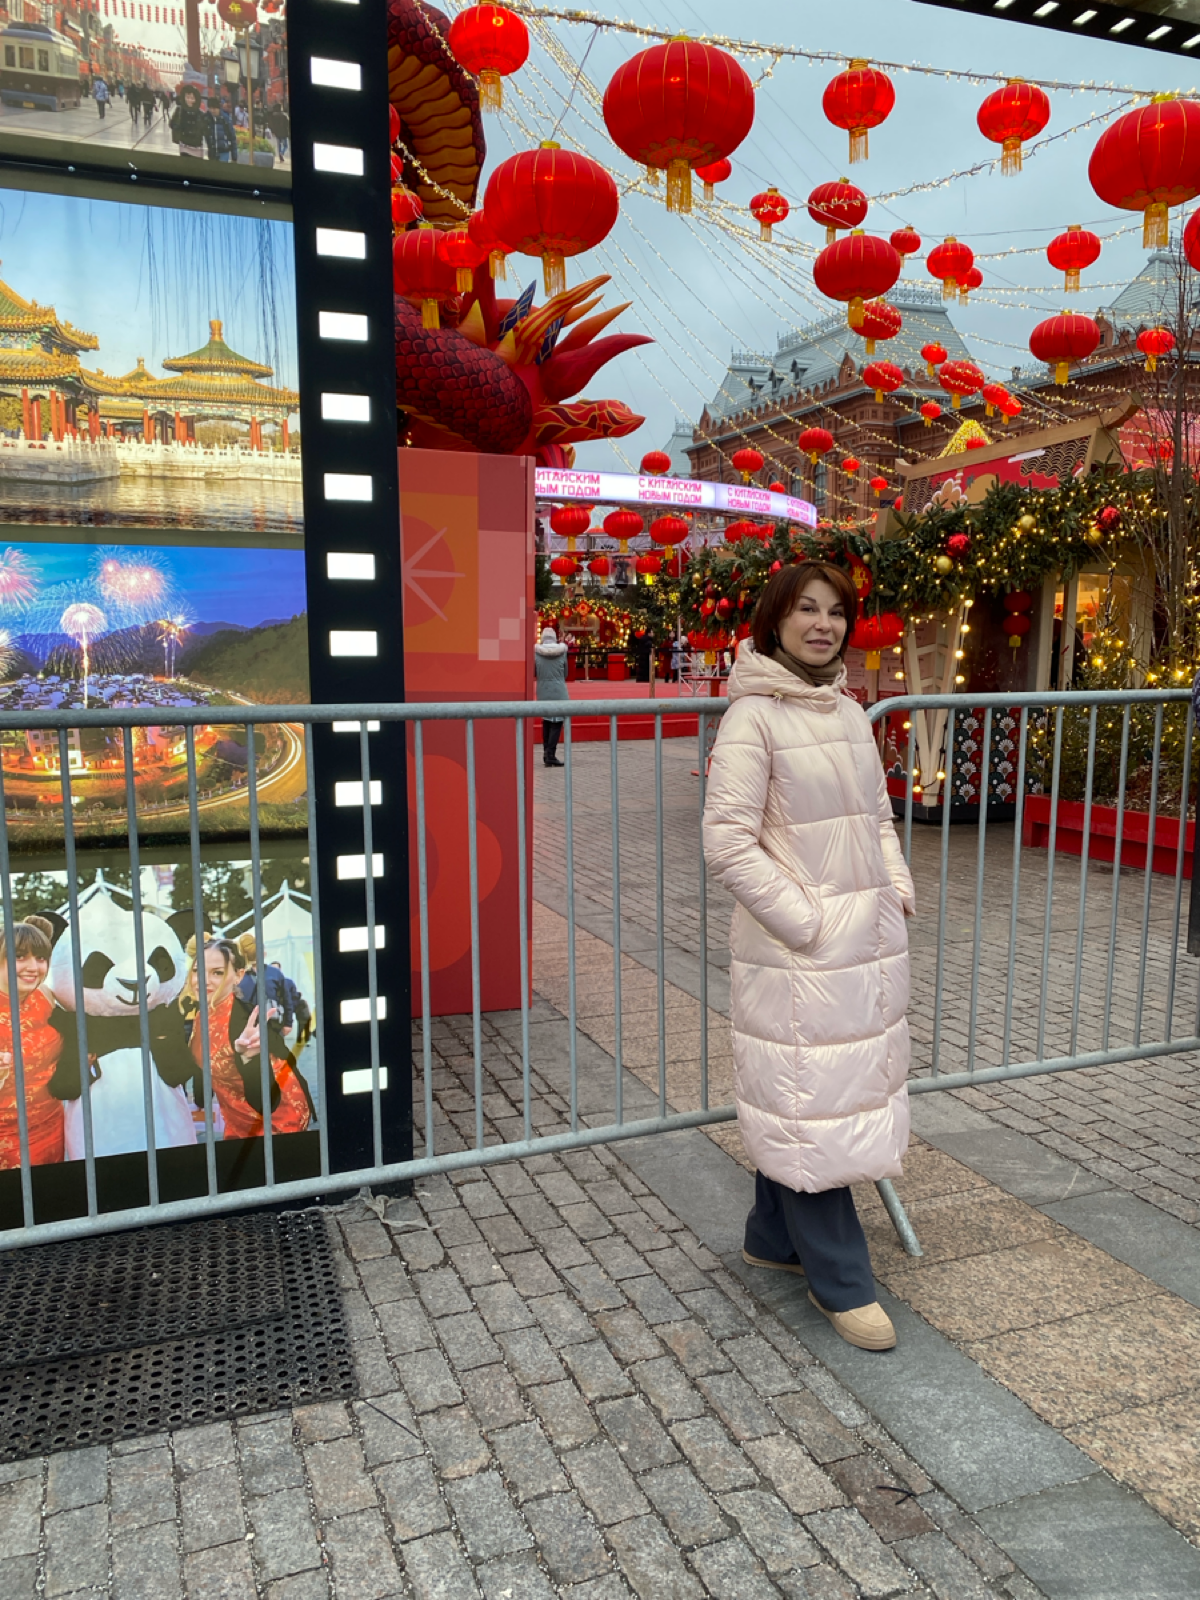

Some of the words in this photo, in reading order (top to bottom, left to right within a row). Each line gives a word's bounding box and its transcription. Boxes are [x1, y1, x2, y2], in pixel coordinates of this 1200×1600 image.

[535, 470, 600, 484] ИТАЙСКИМ
[535, 483, 558, 494] ВЫМ
[562, 485, 600, 497] ГОДОМ
[639, 478, 645, 488] С
[648, 478, 702, 492] КИТАЙСКИМ
[639, 489, 672, 501] НОВЫМ
[673, 492, 702, 505] ГОДОМ
[728, 498, 750, 509] НОВЫМ
